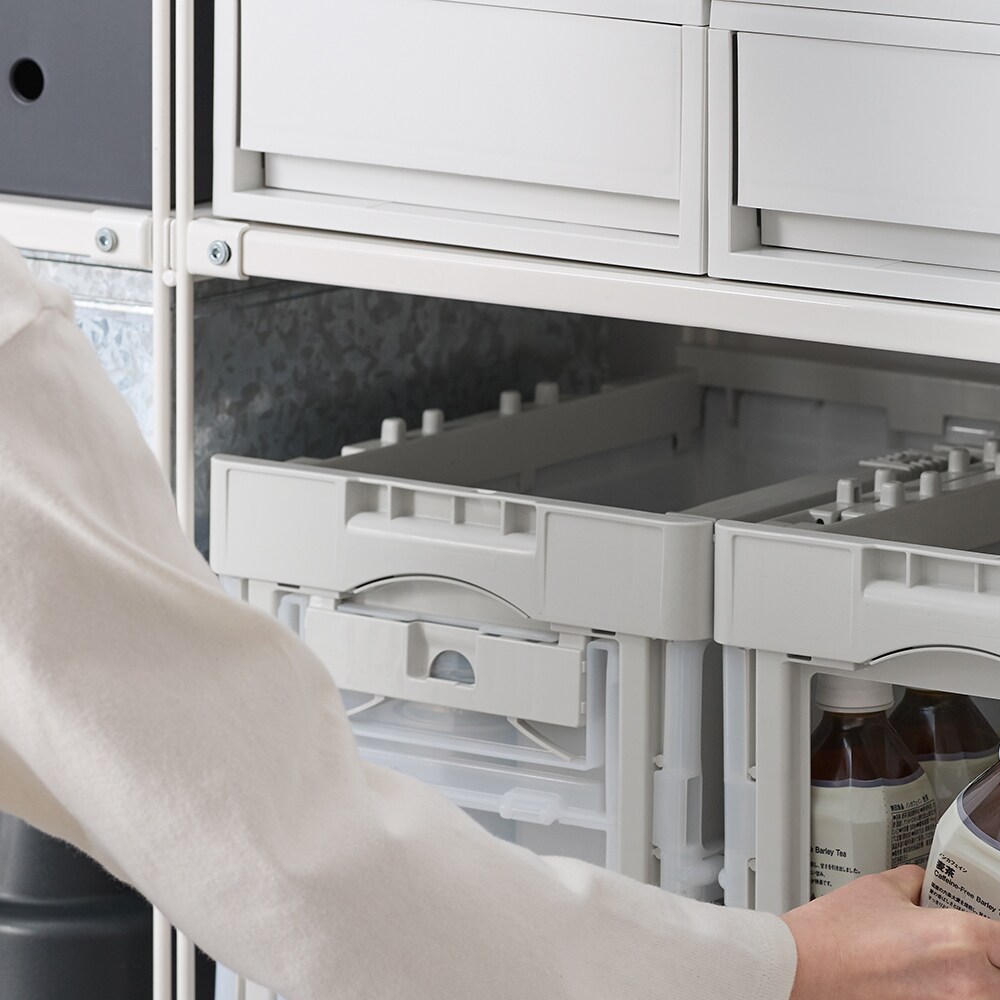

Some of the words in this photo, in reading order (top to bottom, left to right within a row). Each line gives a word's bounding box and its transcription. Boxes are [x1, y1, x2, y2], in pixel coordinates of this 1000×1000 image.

[815, 846, 834, 856] Barley
[836, 849, 846, 857] Tea
[936, 859, 956, 878] 麦茶
[939, 852, 968, 873] ノンカフェイン
[934, 869, 975, 899] Caffeine-Free
[976, 896, 996, 912] Barley
